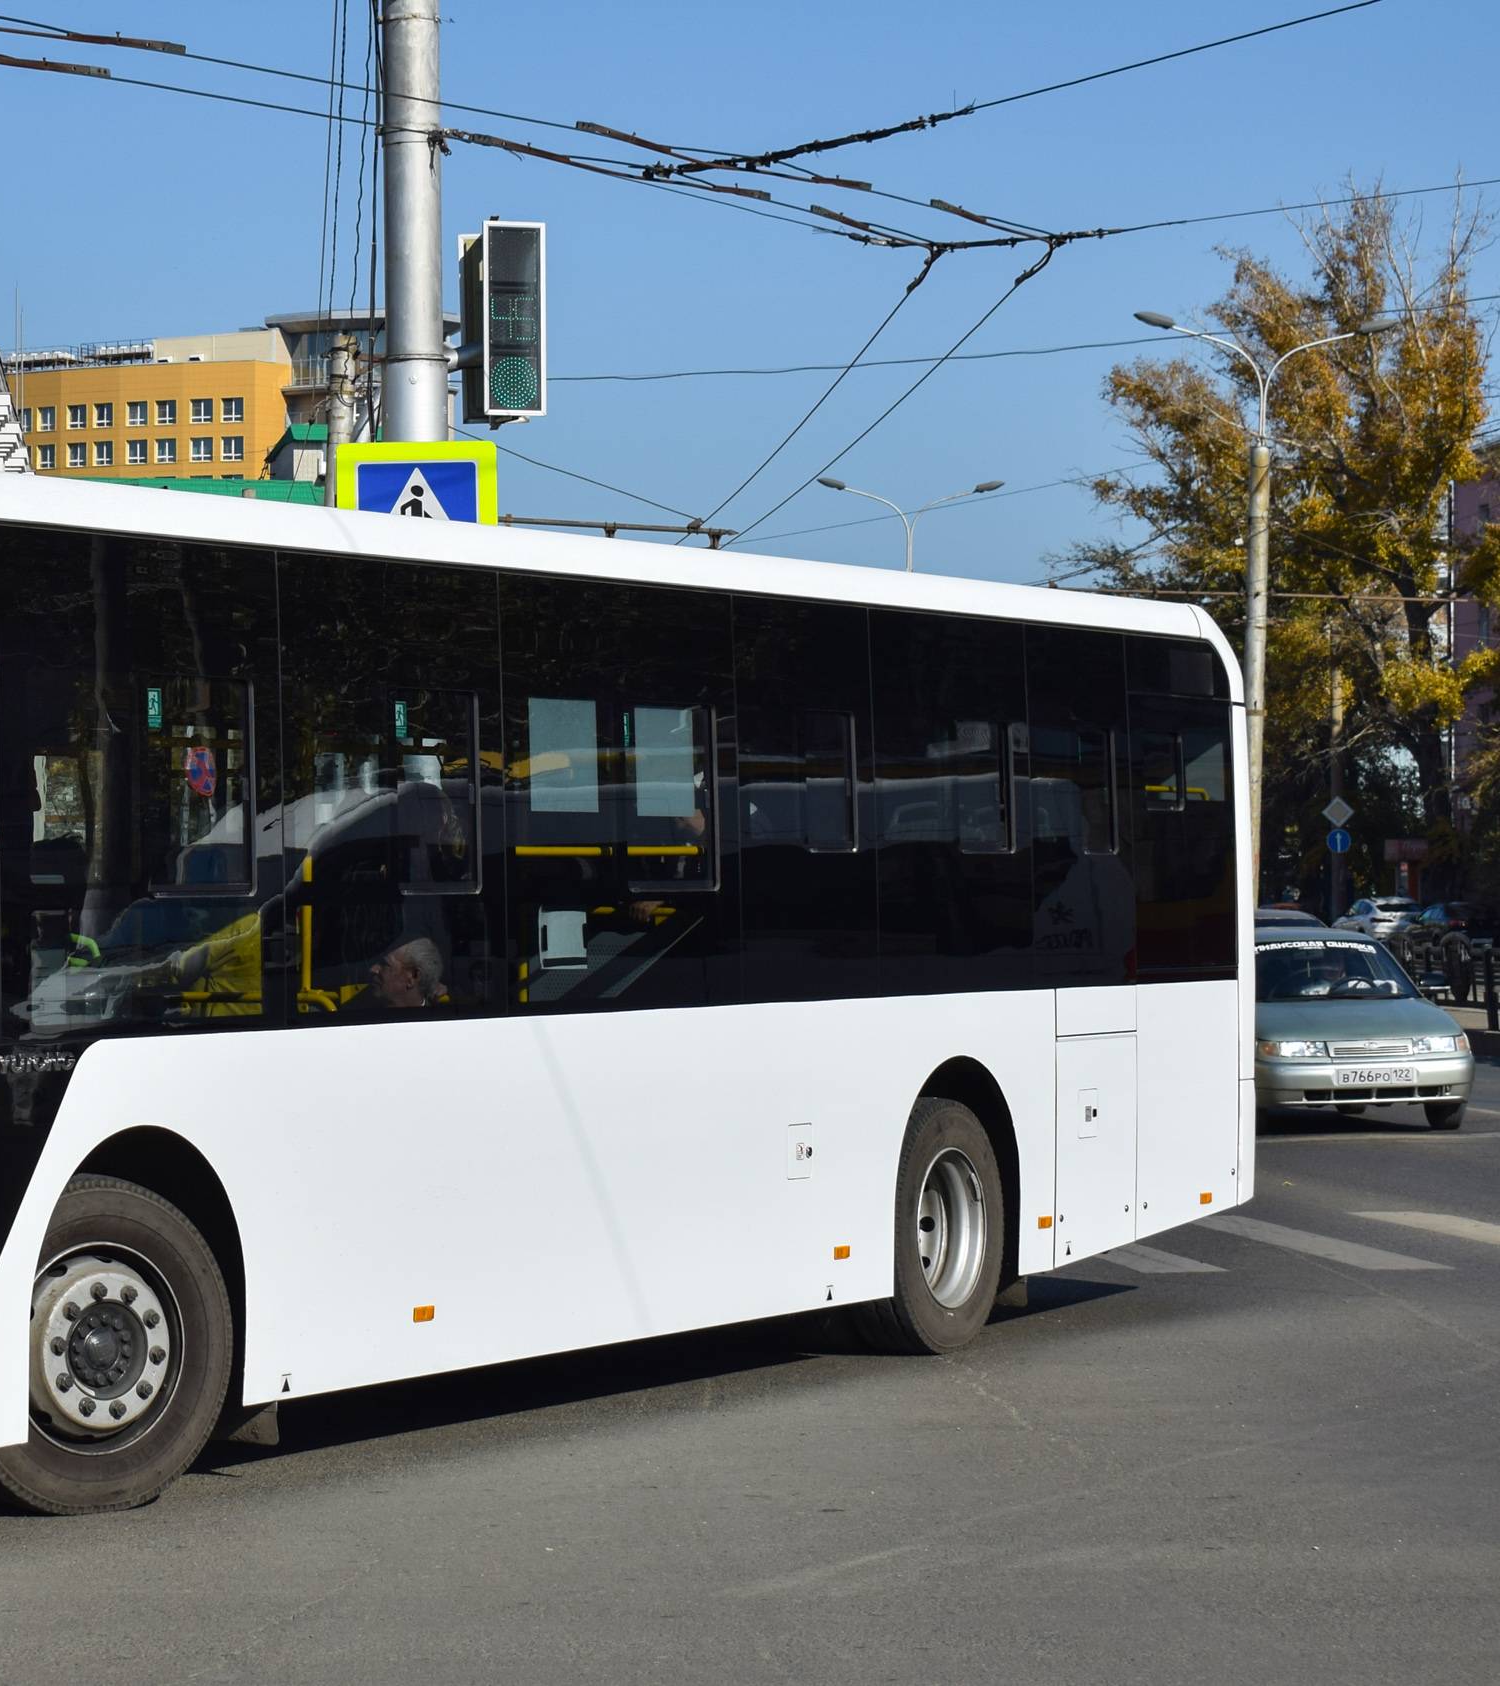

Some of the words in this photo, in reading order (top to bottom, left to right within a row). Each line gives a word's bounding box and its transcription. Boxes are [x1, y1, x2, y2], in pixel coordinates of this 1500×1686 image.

[491, 297, 537, 341] 45
[1255, 941, 1324, 952] ИНАНСОВАЯ
[1342, 1070, 1391, 1083] В766РО
[1393, 1069, 1410, 1079] 122
